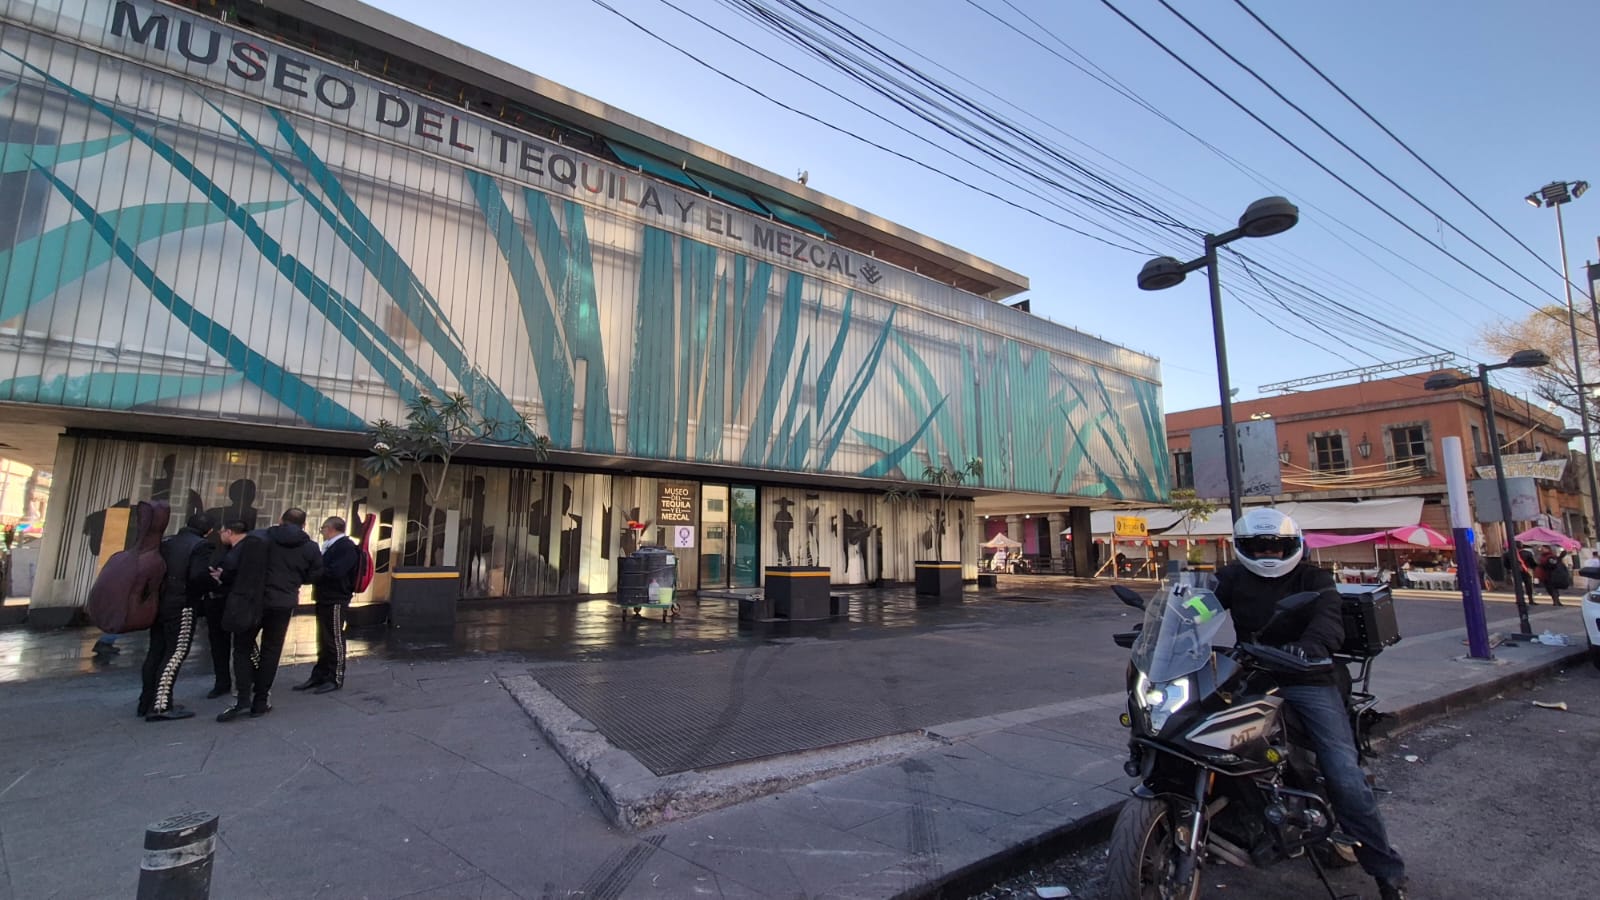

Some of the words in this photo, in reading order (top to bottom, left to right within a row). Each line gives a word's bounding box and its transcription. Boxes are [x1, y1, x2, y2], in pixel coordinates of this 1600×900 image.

[110, 1, 356, 111] MUSEO
[375, 89, 474, 153] DEL
[491, 130, 663, 216] TEQUILA
[674, 194, 695, 223] Y
[705, 204, 742, 241] EL
[753, 224, 857, 279] MEZCAL
[661, 500, 691, 508] TEQUILA
[1230, 726, 1256, 746] MT
